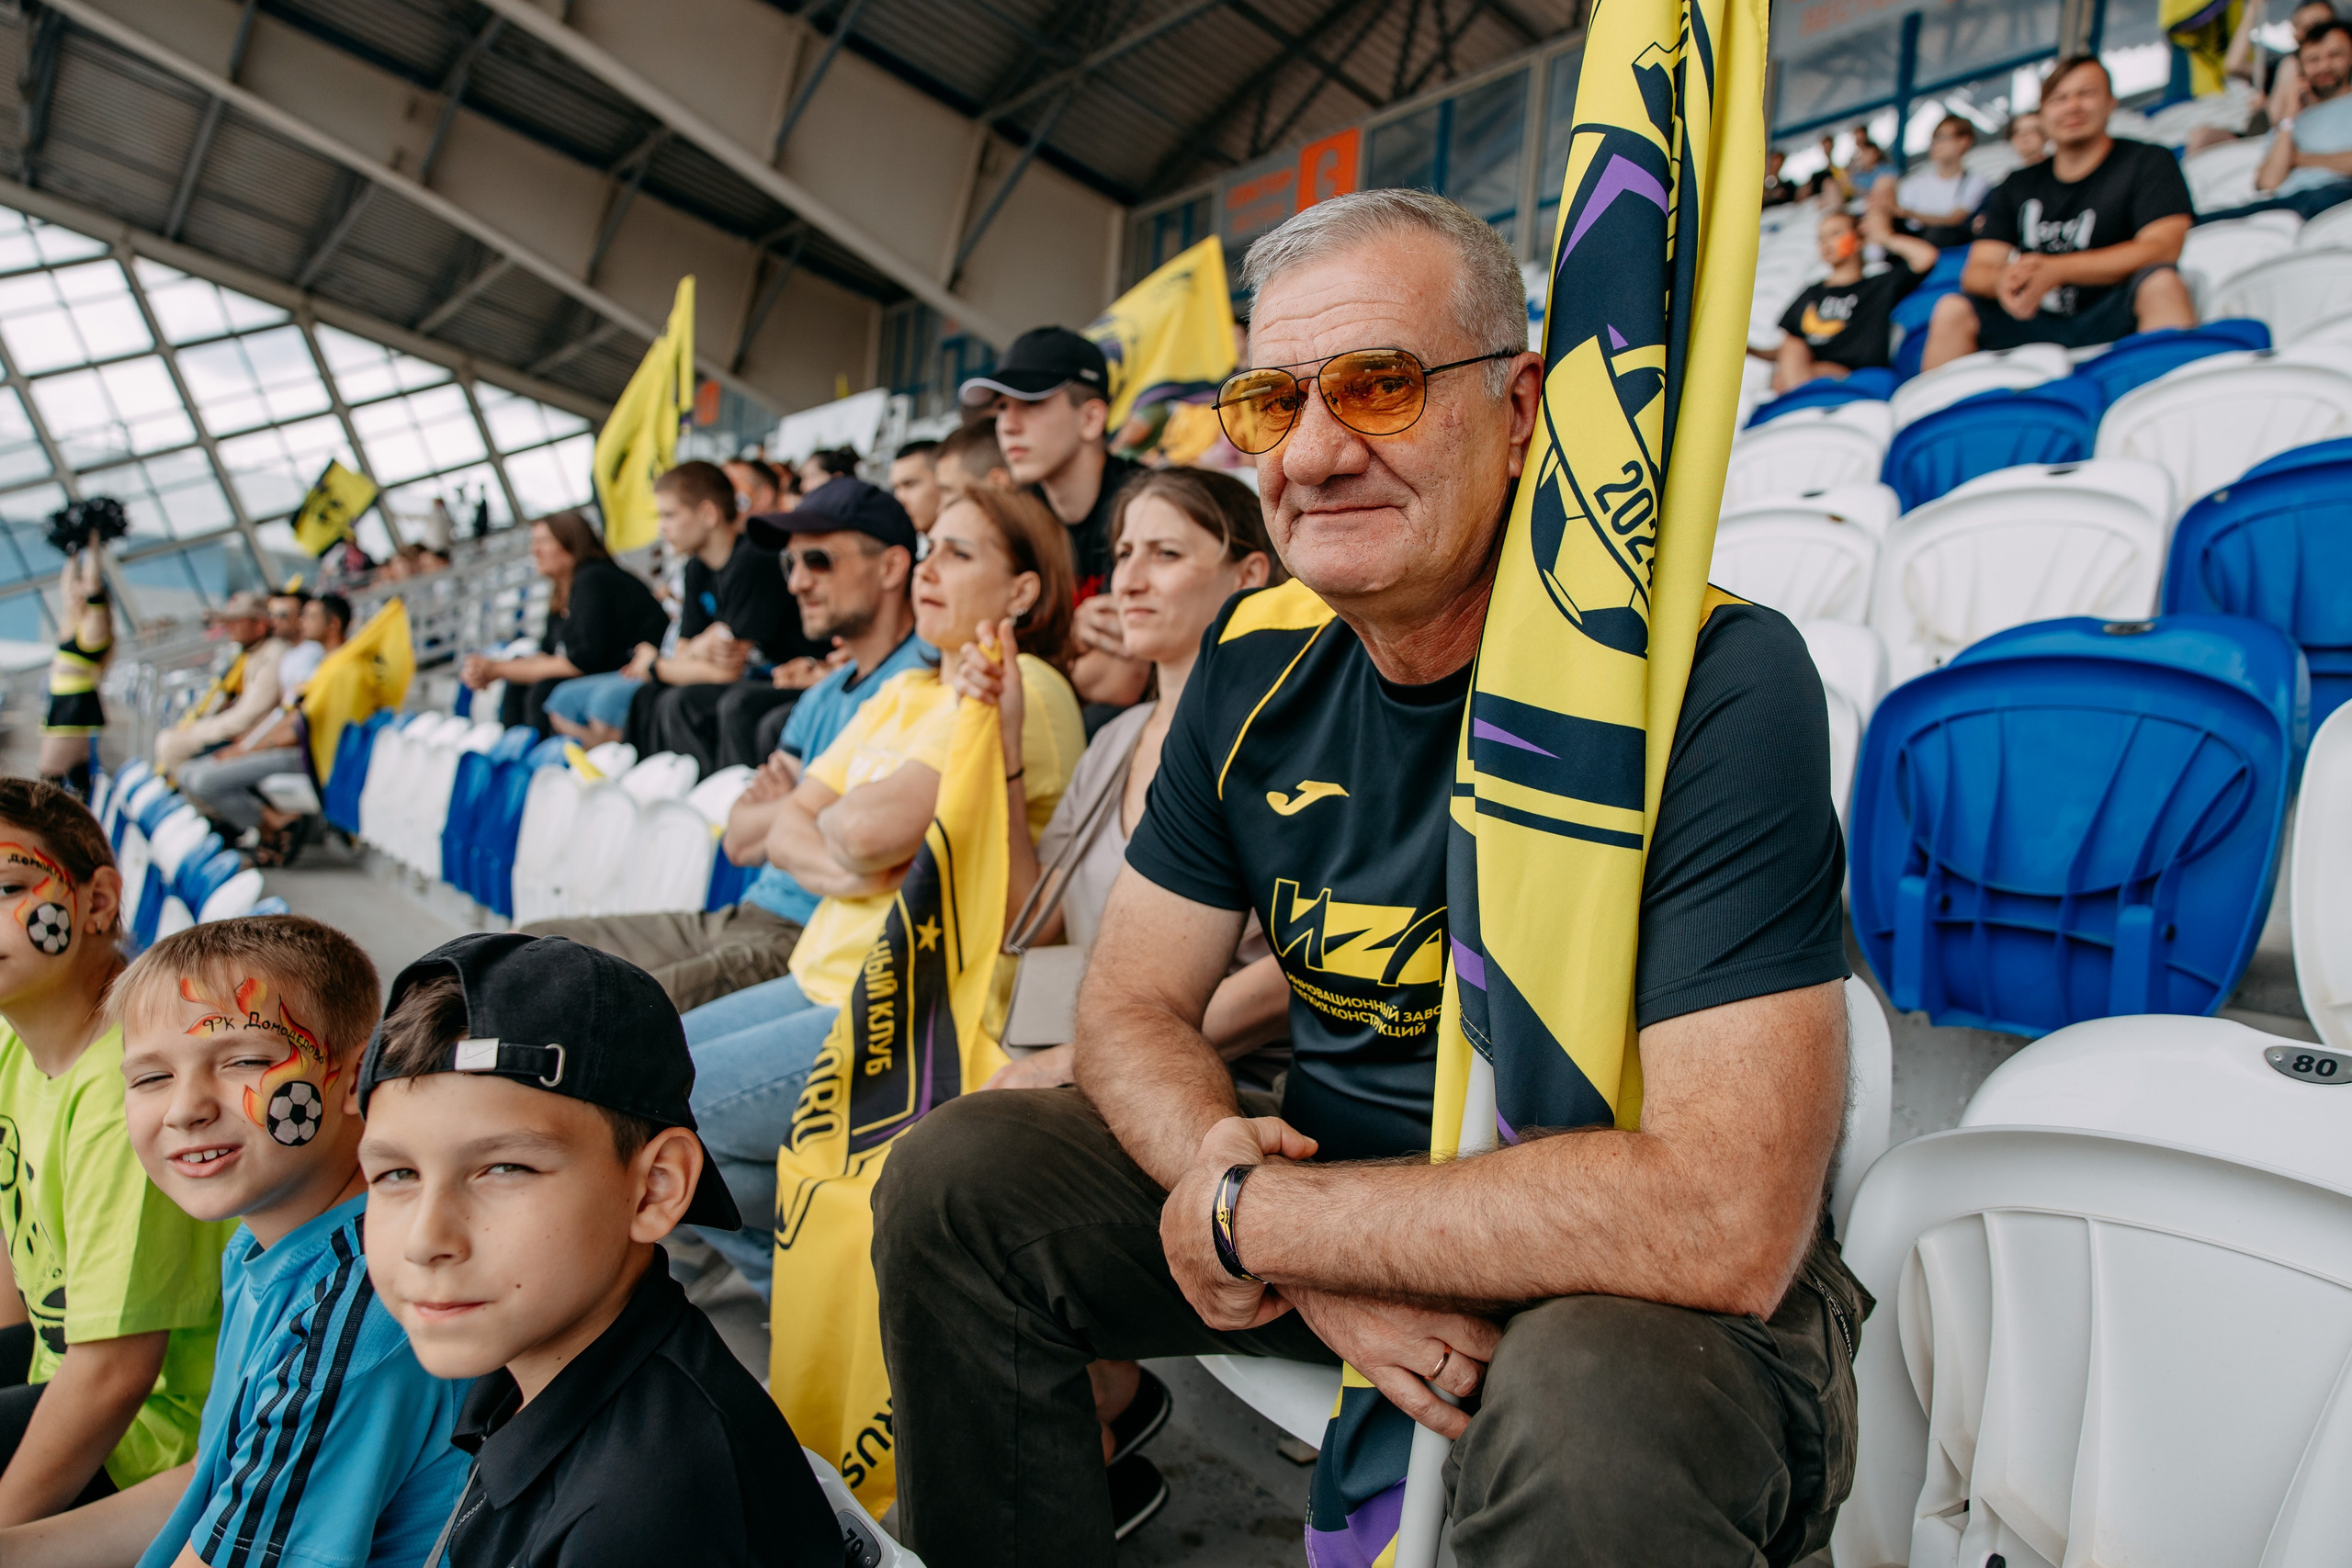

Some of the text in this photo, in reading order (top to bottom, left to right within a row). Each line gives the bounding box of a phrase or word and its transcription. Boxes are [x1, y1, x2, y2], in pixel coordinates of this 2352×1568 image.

[864, 927, 899, 1077] НЫЙ КЛУБ
[1285, 970, 1400, 1022] ИННОВАЦИОННЫЙ
[201, 1015, 236, 1033] ФК
[2291, 1054, 2338, 1077] 80
[843, 1527, 865, 1560] 79
